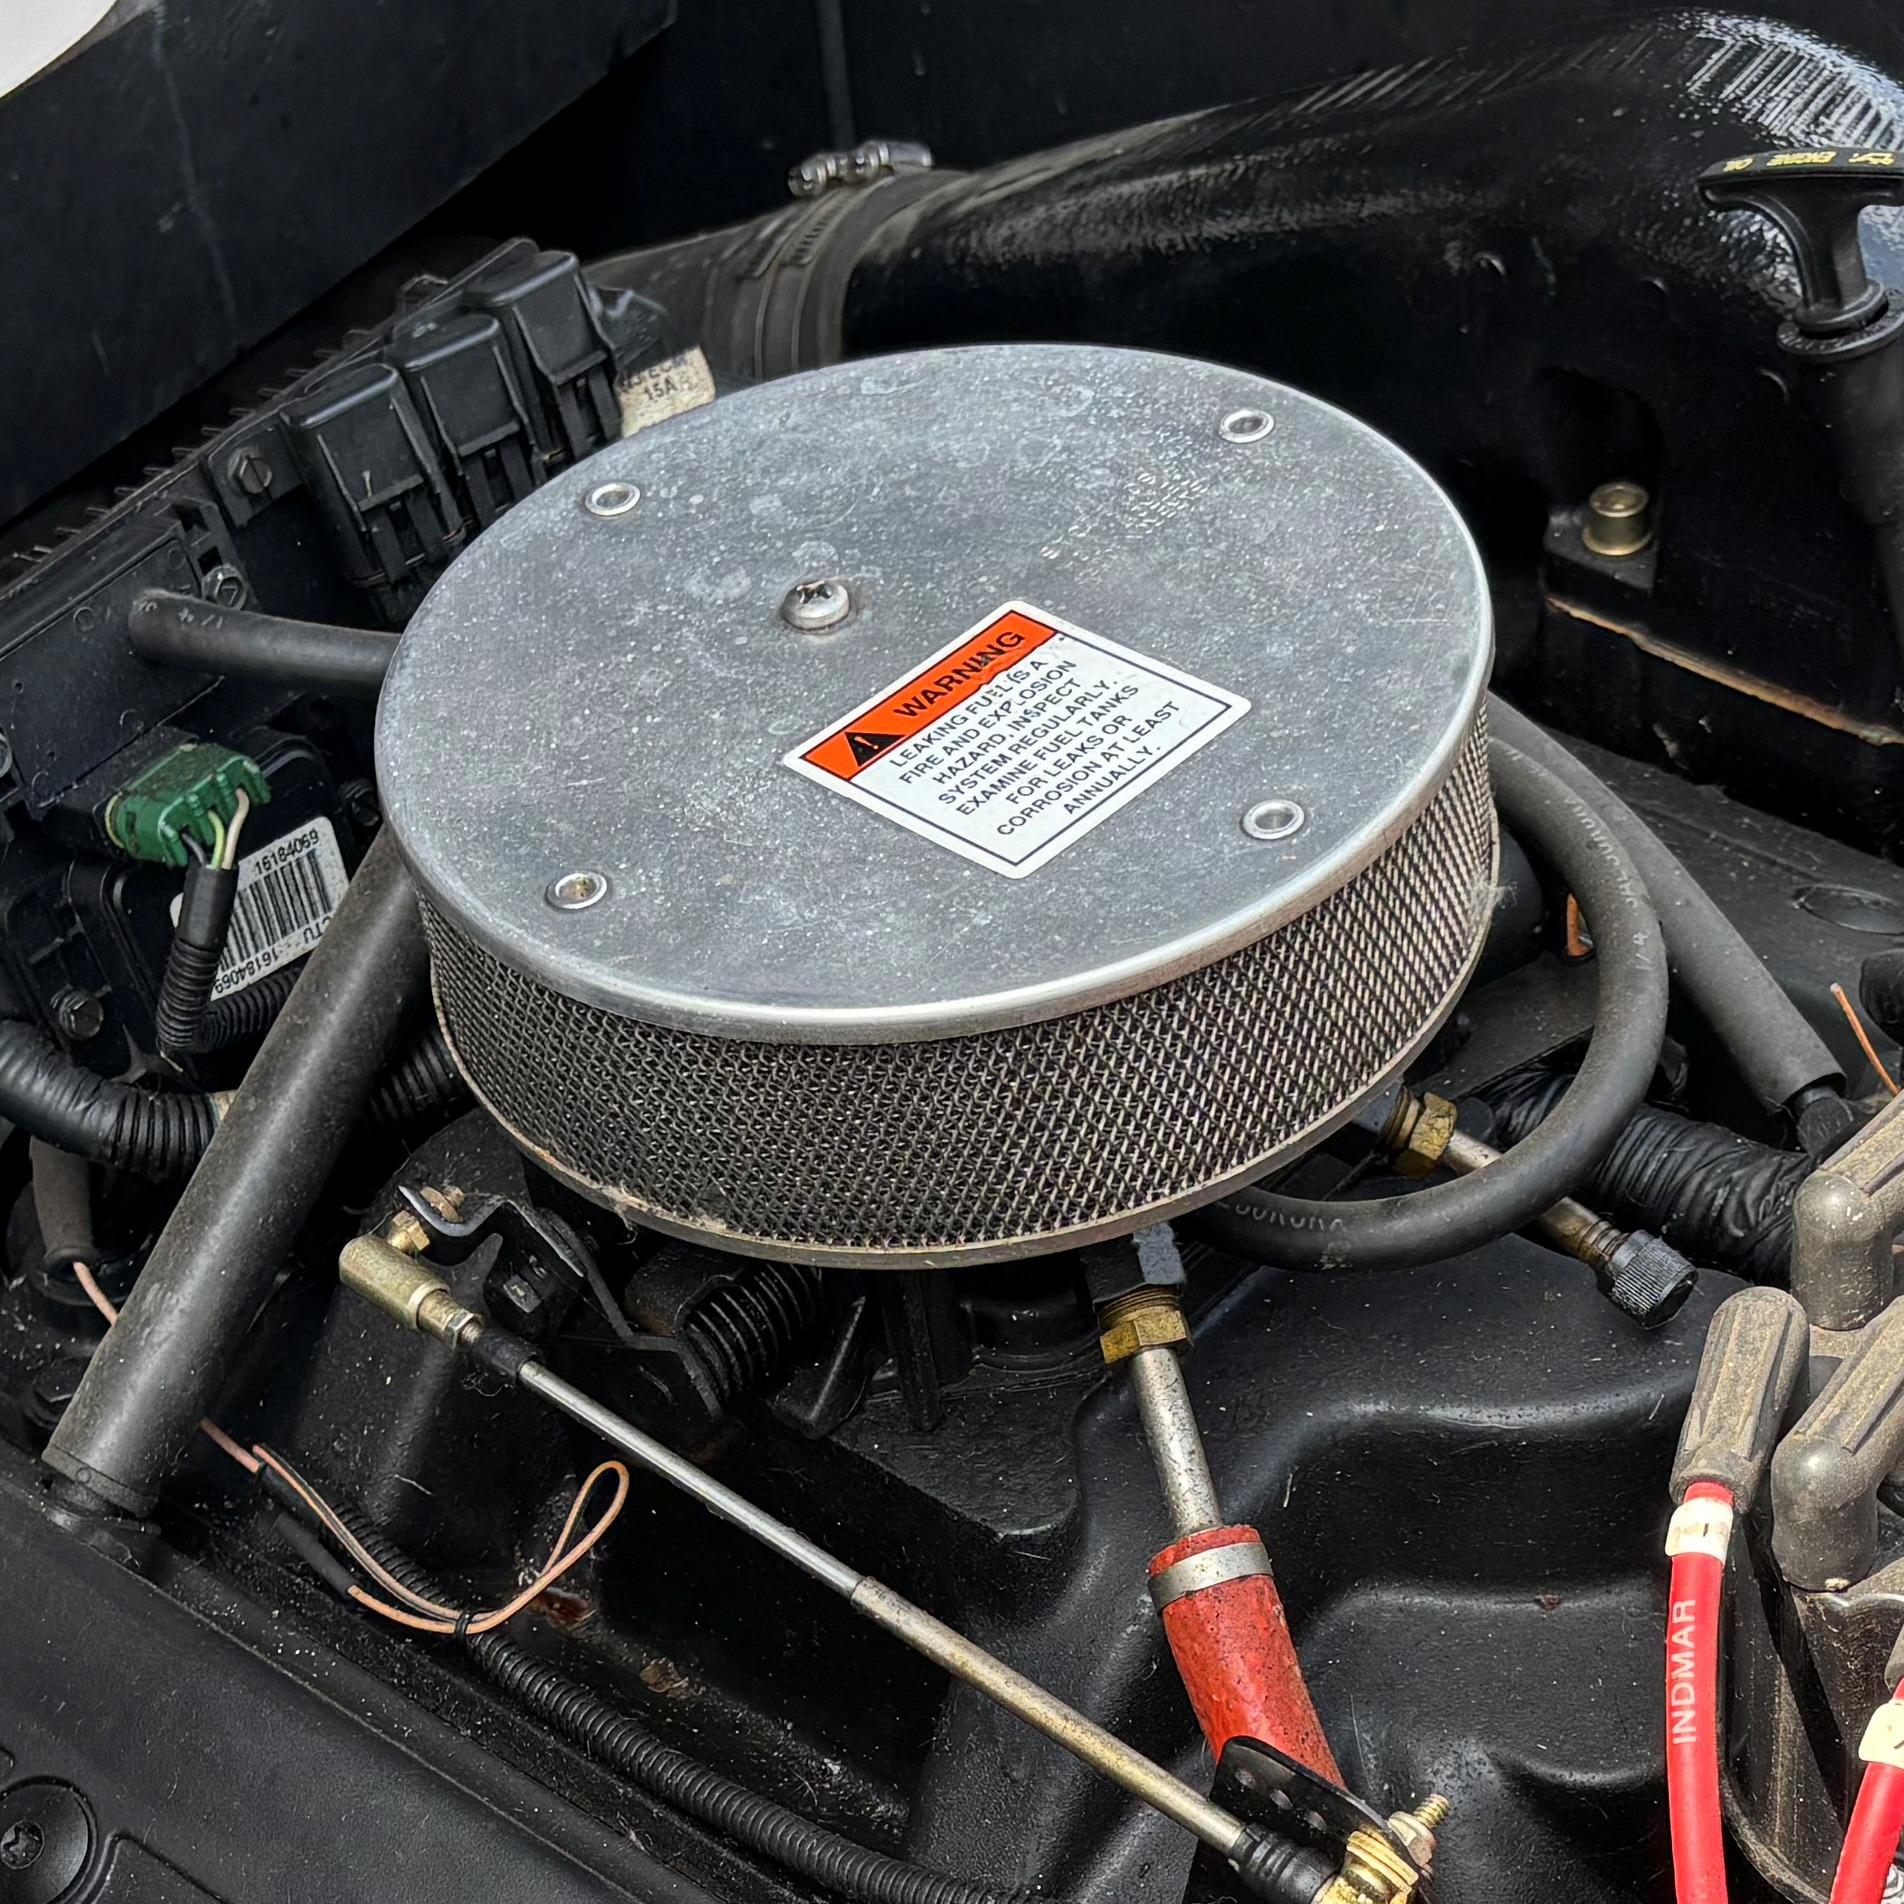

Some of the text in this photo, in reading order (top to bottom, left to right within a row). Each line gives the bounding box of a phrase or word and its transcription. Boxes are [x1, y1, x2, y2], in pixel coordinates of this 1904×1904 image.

[890, 714, 969, 767] LEAKING
[1030, 660, 1048, 671] A
[893, 631, 1026, 717] WARNING
[1007, 678, 1081, 731] INSPECT
[899, 754, 944, 784] FIRE
[942, 728, 980, 756] AND
[938, 680, 1118, 804] SYSTEM REGULARLY.
[956, 685, 1139, 815] EXAMINE FUEL TANKS
[997, 701, 1180, 835] CORROSION AT LEAST
[1006, 715, 1133, 804] FOR LEAKS OR
[1063, 746, 1161, 814] ANNUALLY.
[255, 828, 320, 875] 16184069
[1671, 1600, 1697, 1745] INDMAR
